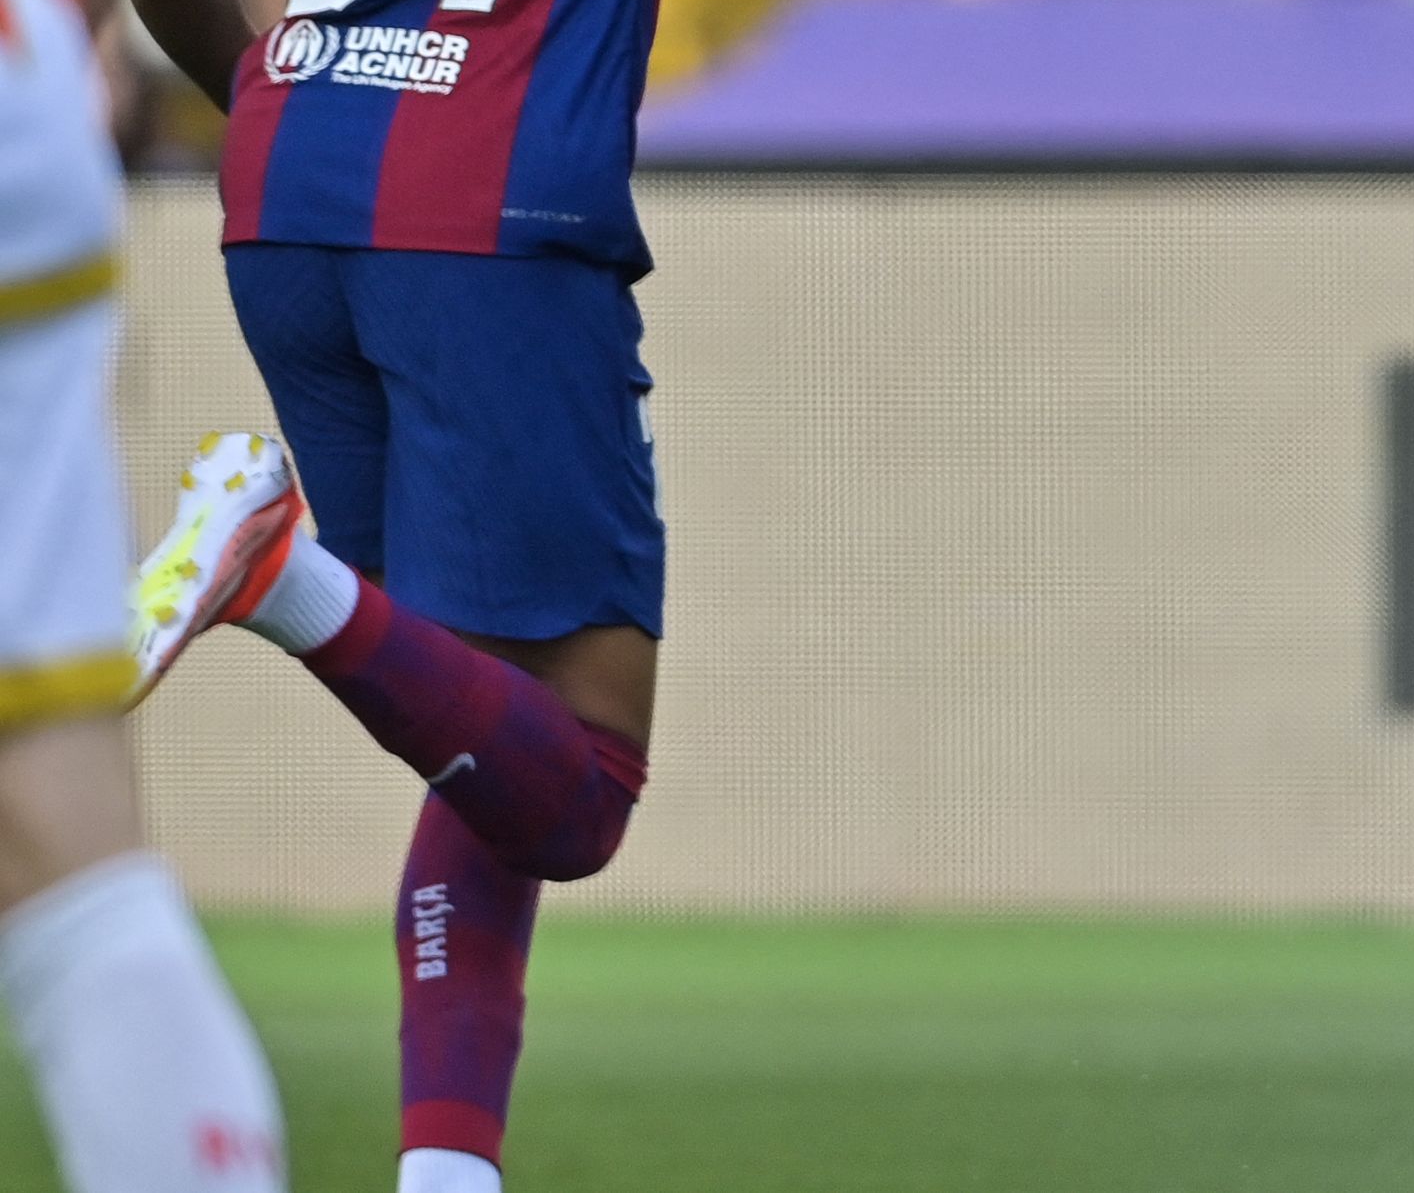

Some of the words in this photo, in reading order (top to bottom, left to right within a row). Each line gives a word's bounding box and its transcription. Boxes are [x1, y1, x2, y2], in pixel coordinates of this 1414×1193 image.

[344, 26, 470, 62] UNHCR
[332, 51, 462, 84] ACNUR
[412, 883, 455, 979] BARÇA
